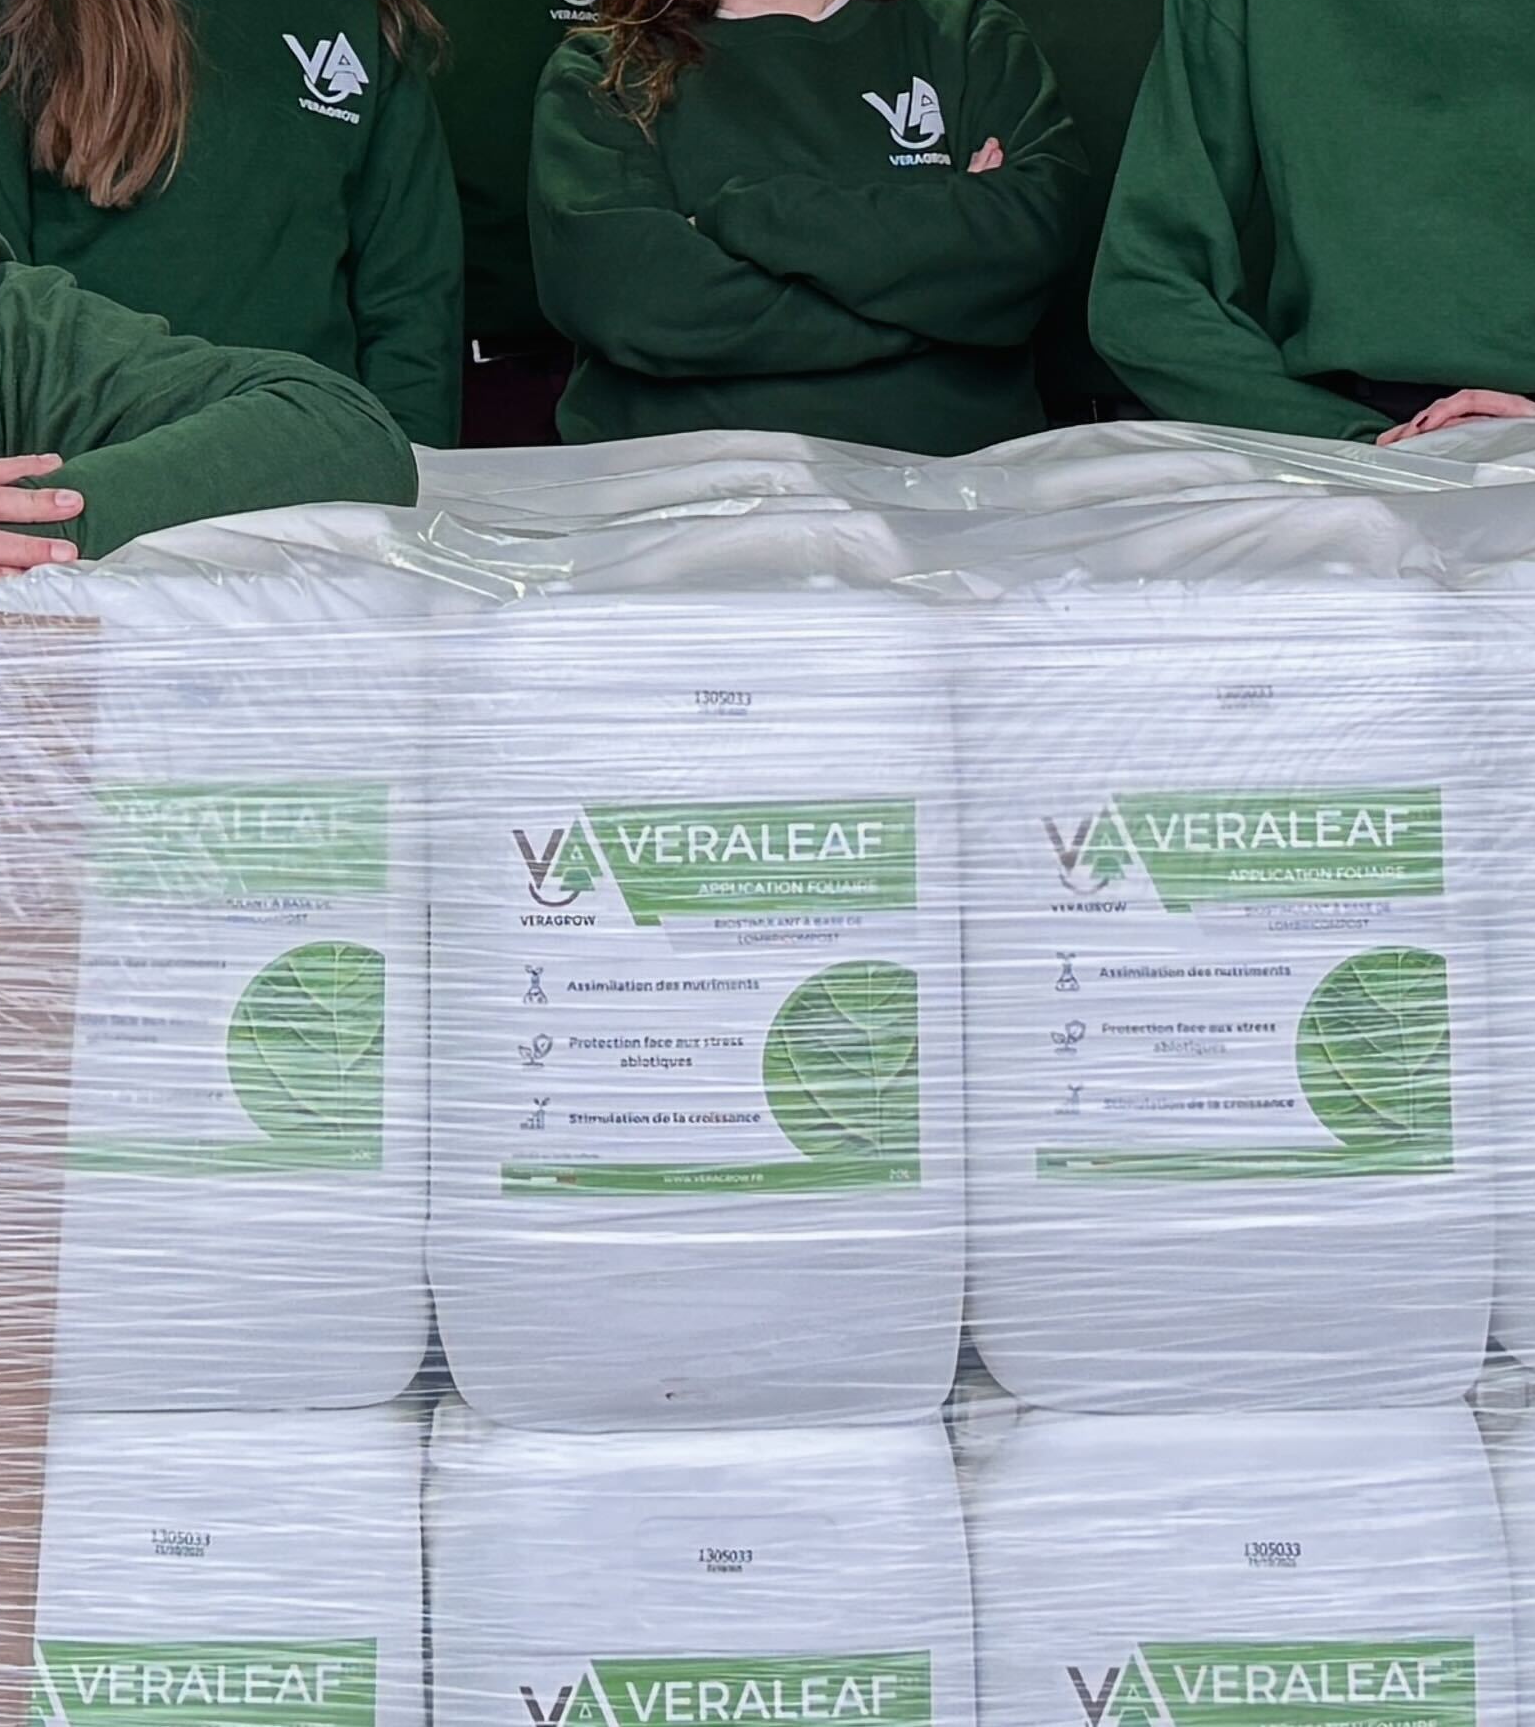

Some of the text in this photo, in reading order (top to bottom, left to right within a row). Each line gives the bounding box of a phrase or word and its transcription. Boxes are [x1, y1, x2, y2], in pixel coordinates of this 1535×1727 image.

[1145, 808, 1410, 851] VERALEAF
[617, 822, 884, 865] VERALEAF
[698, 881, 803, 895] APPLICATION
[520, 914, 597, 927] VERAGROW
[1188, 966, 1211, 978] des
[567, 979, 653, 992] Assimilation
[656, 979, 680, 992] des
[568, 1036, 641, 1049] Protection
[644, 1036, 673, 1049] face
[569, 1113, 650, 1125] Stimulation
[673, 1113, 686, 1125] la
[71, 1664, 341, 1705] VERALEAF
[1173, 1659, 1443, 1704] VERALEAF
[626, 1675, 898, 1722] VERALEAF
